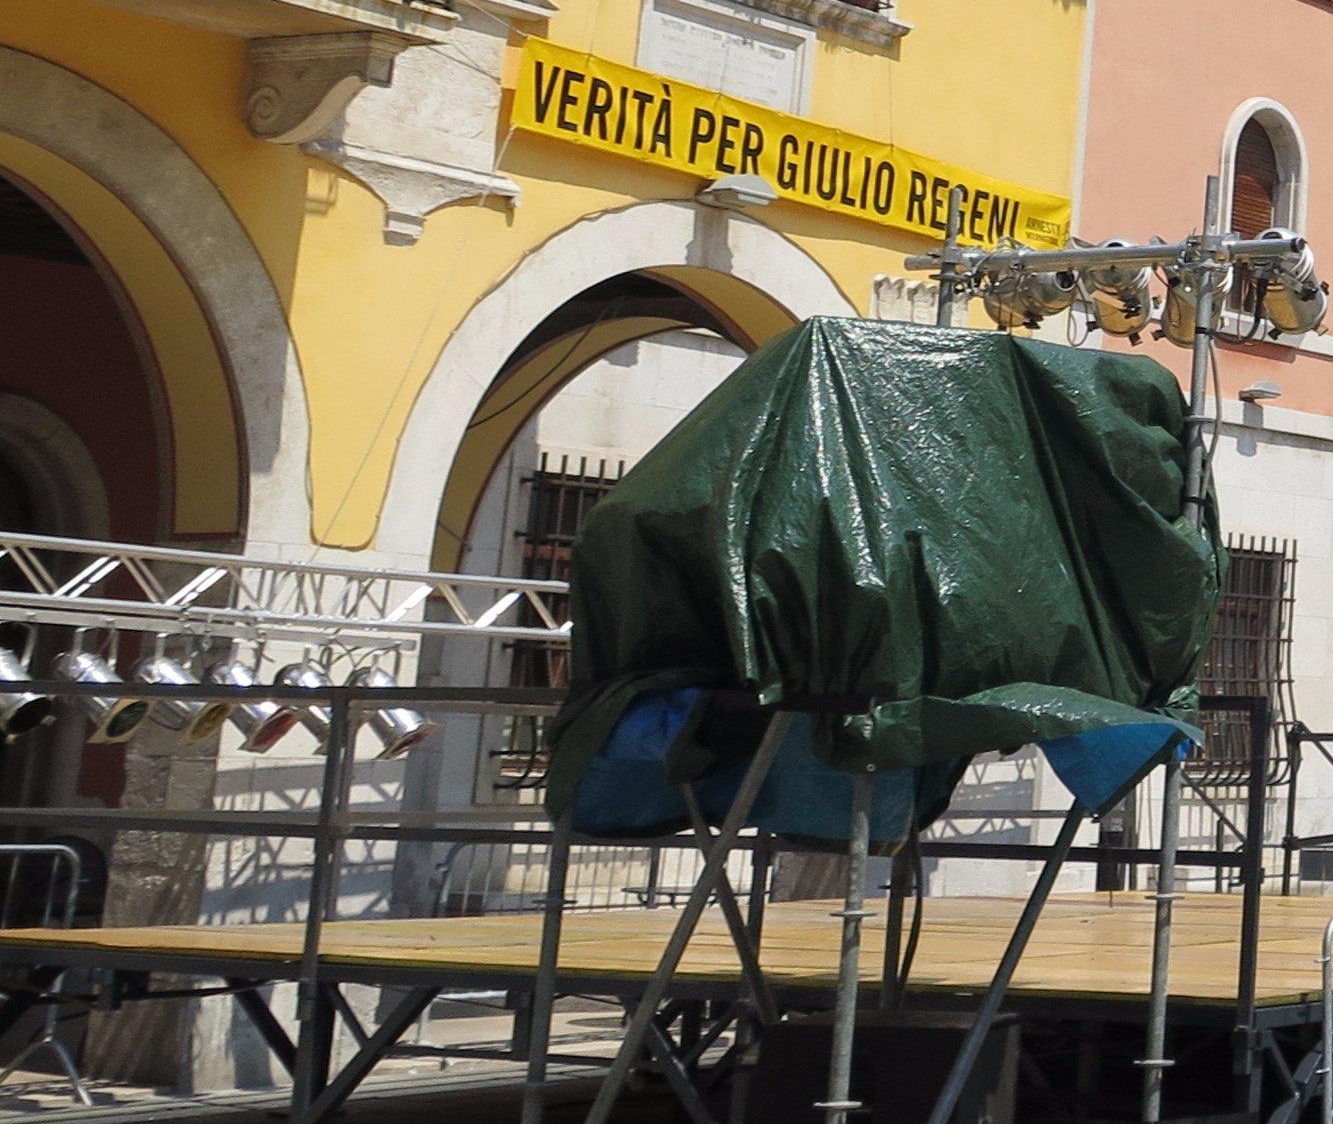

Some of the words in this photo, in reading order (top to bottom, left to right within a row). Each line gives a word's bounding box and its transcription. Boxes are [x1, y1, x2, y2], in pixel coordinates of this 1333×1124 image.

[534, 60, 673, 159] VERITÀ
[687, 106, 765, 176] PER
[775, 133, 896, 216] GIULIO
[905, 168, 1021, 245] REGENI
